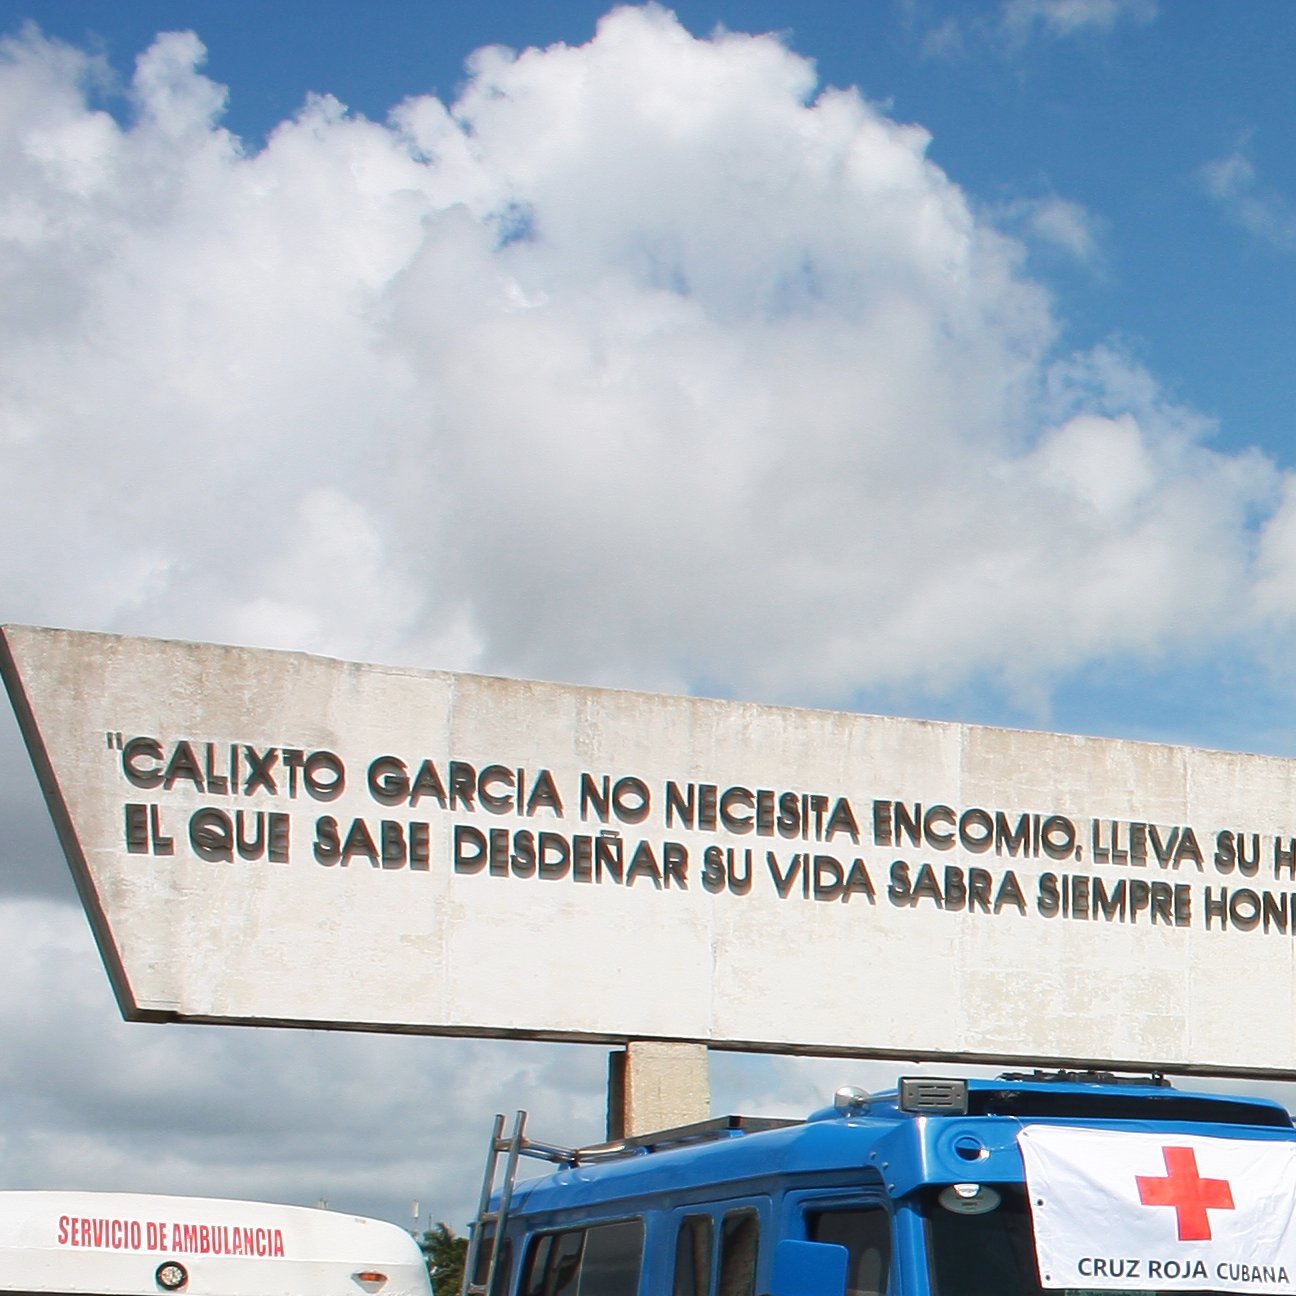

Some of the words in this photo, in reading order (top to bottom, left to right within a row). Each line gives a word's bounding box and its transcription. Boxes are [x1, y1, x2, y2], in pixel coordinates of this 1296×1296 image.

[106, 732, 346, 803] "CALIXTO
[367, 755, 563, 819] GARCIA
[580, 773, 651, 825] NO
[665, 780, 860, 845] NECESITA
[1093, 818, 1204, 872] LLEVA
[1214, 830, 1260, 878] SU
[125, 803, 174, 857] EL
[188, 807, 290, 865] QUE
[313, 815, 431, 872] SABE
[454, 824, 689, 890] DESDEÑAR
[702, 845, 753, 896] SU
[766, 850, 876, 905] VIDA
[888, 860, 1027, 917] SABRA
[1037, 872, 1191, 927] SIEMPRE
[58, 1215, 142, 1250] SERVICIO
[147, 1222, 168, 1251] DE
[172, 1223, 285, 1257] AMBULANCIA
[1078, 1258, 1141, 1278] CRUZ
[1148, 1260, 1208, 1279] ROJA
[1216, 1262, 1290, 1284] CUBANA
